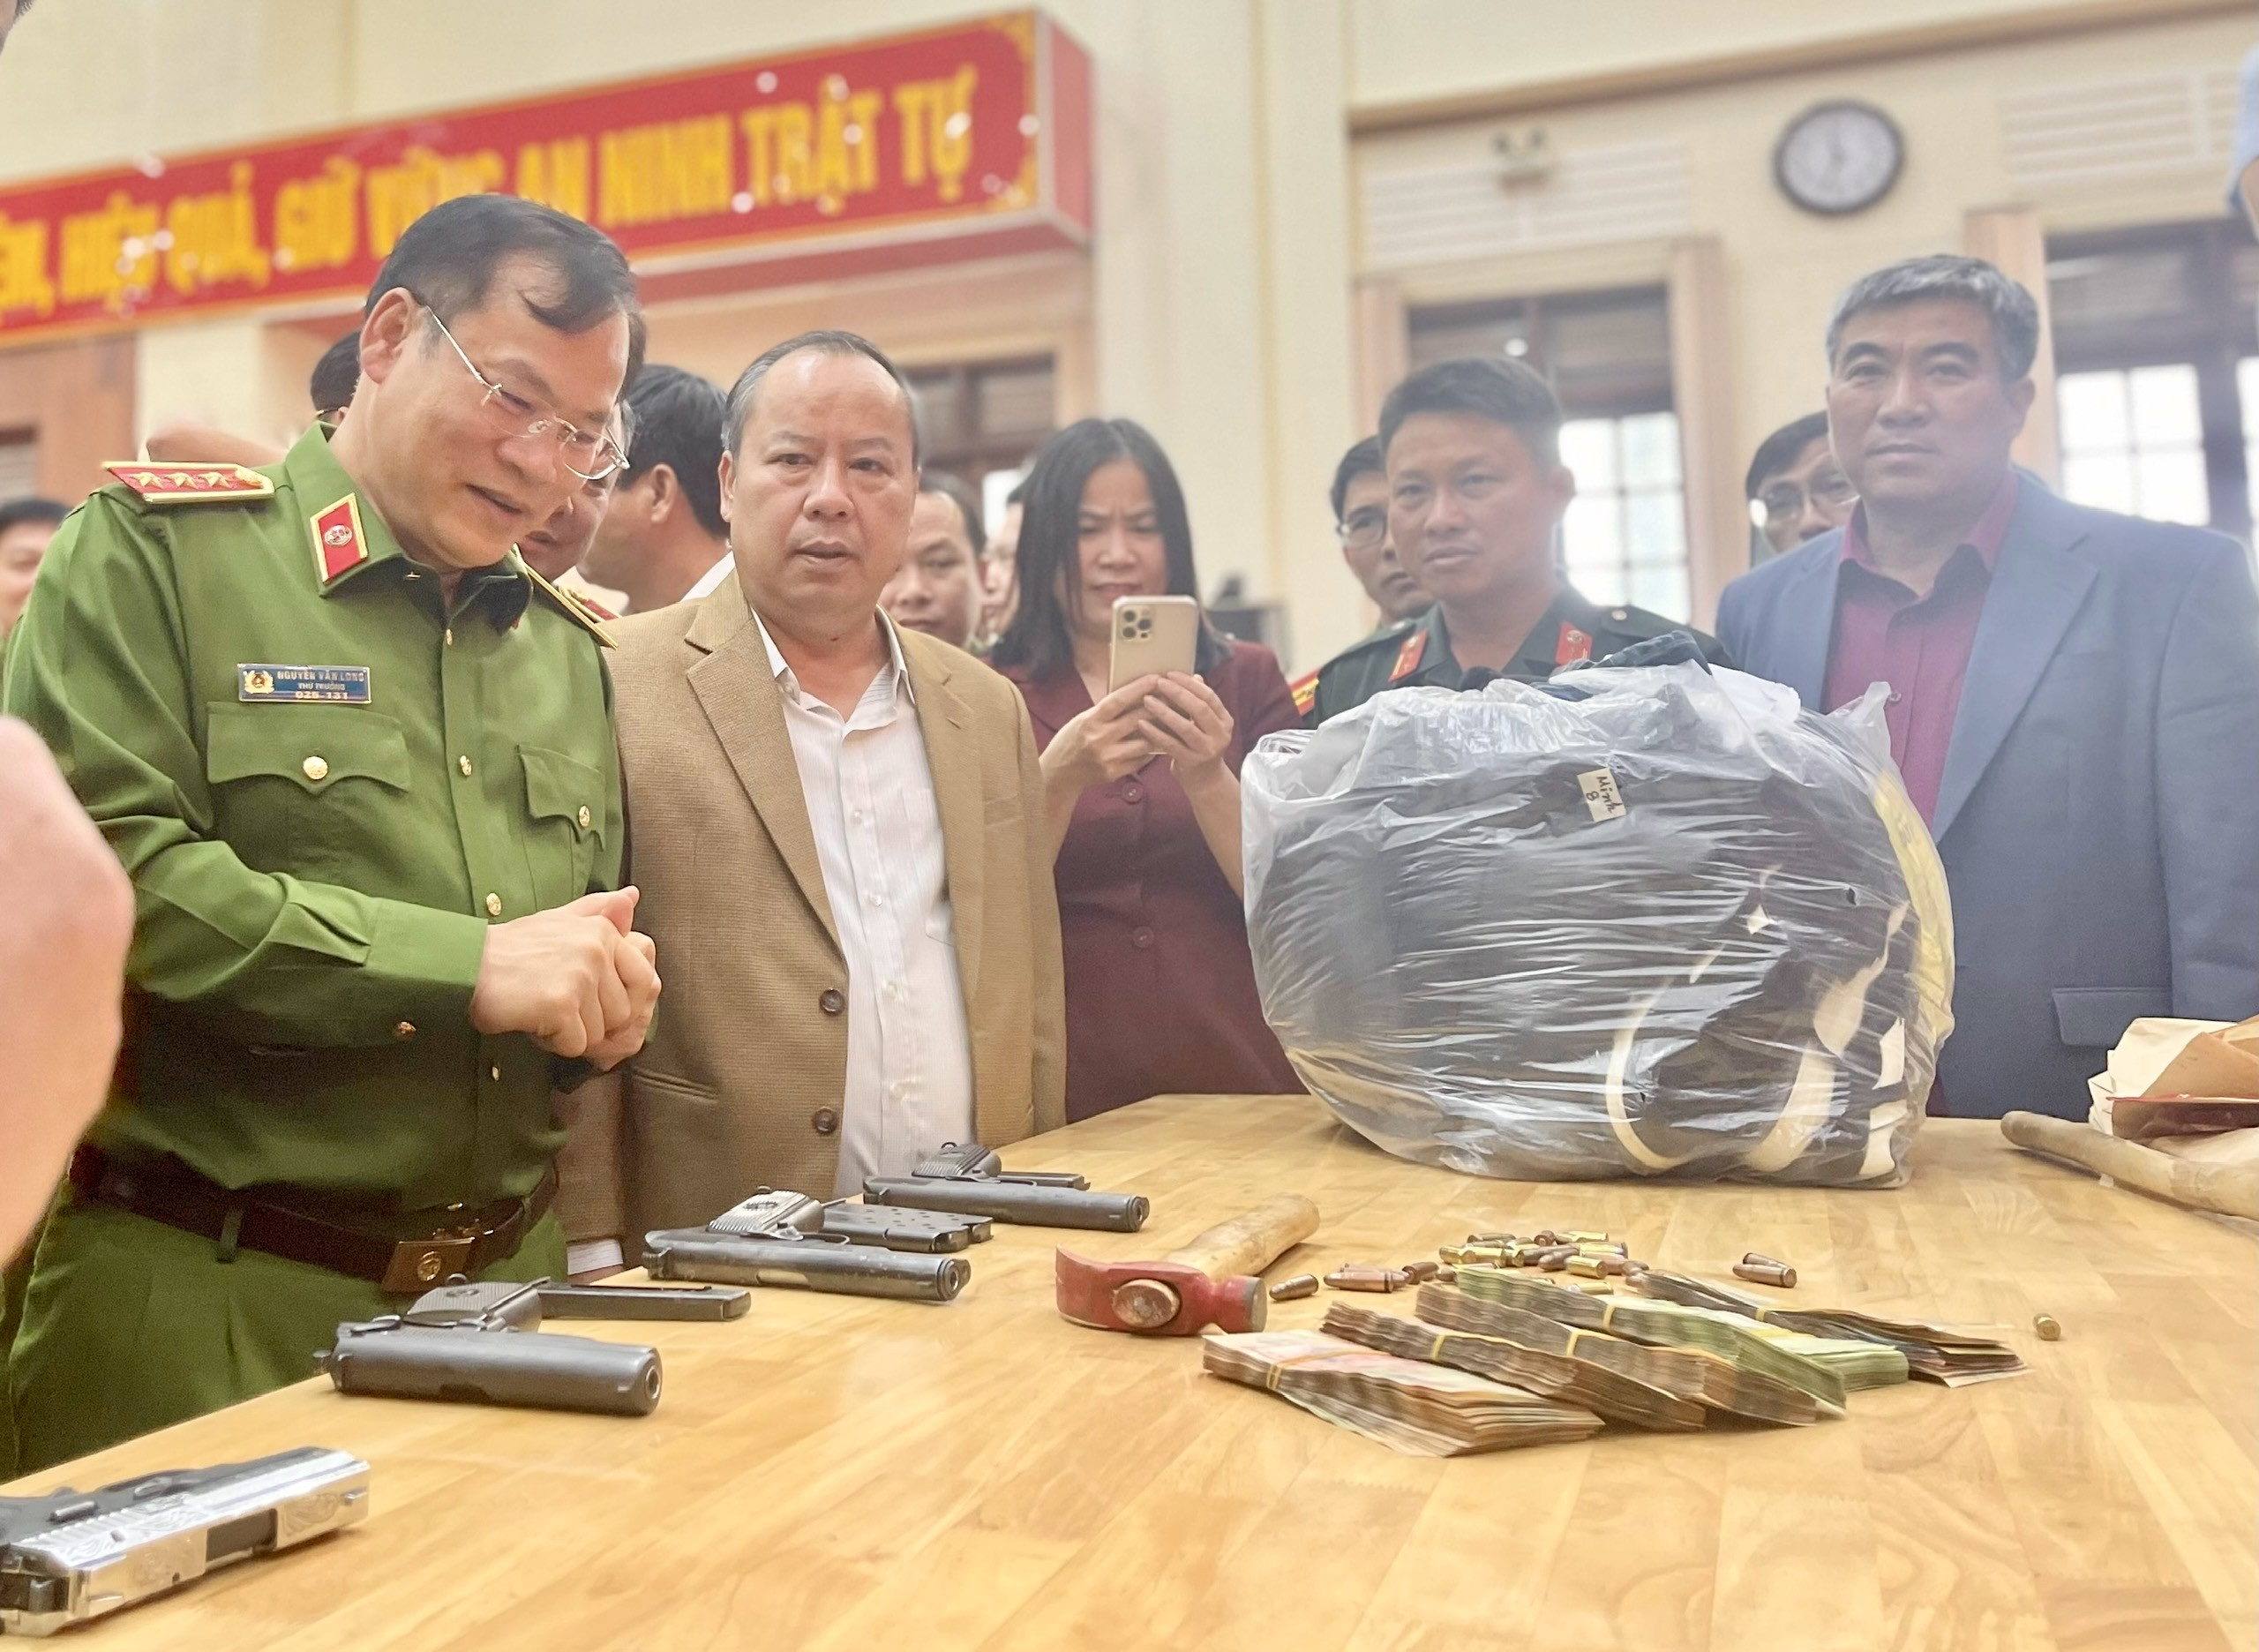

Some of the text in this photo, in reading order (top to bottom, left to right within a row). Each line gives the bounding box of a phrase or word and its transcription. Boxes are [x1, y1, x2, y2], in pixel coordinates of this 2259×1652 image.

[597, 113, 732, 228] NINH
[742, 74, 881, 217] TRẬT
[894, 62, 979, 202] TỰ
[318, 670, 339, 681] VĂN
[340, 672, 364, 682] LONG
[1586, 791, 1600, 801] 8
[1596, 776, 1623, 814] Minh
